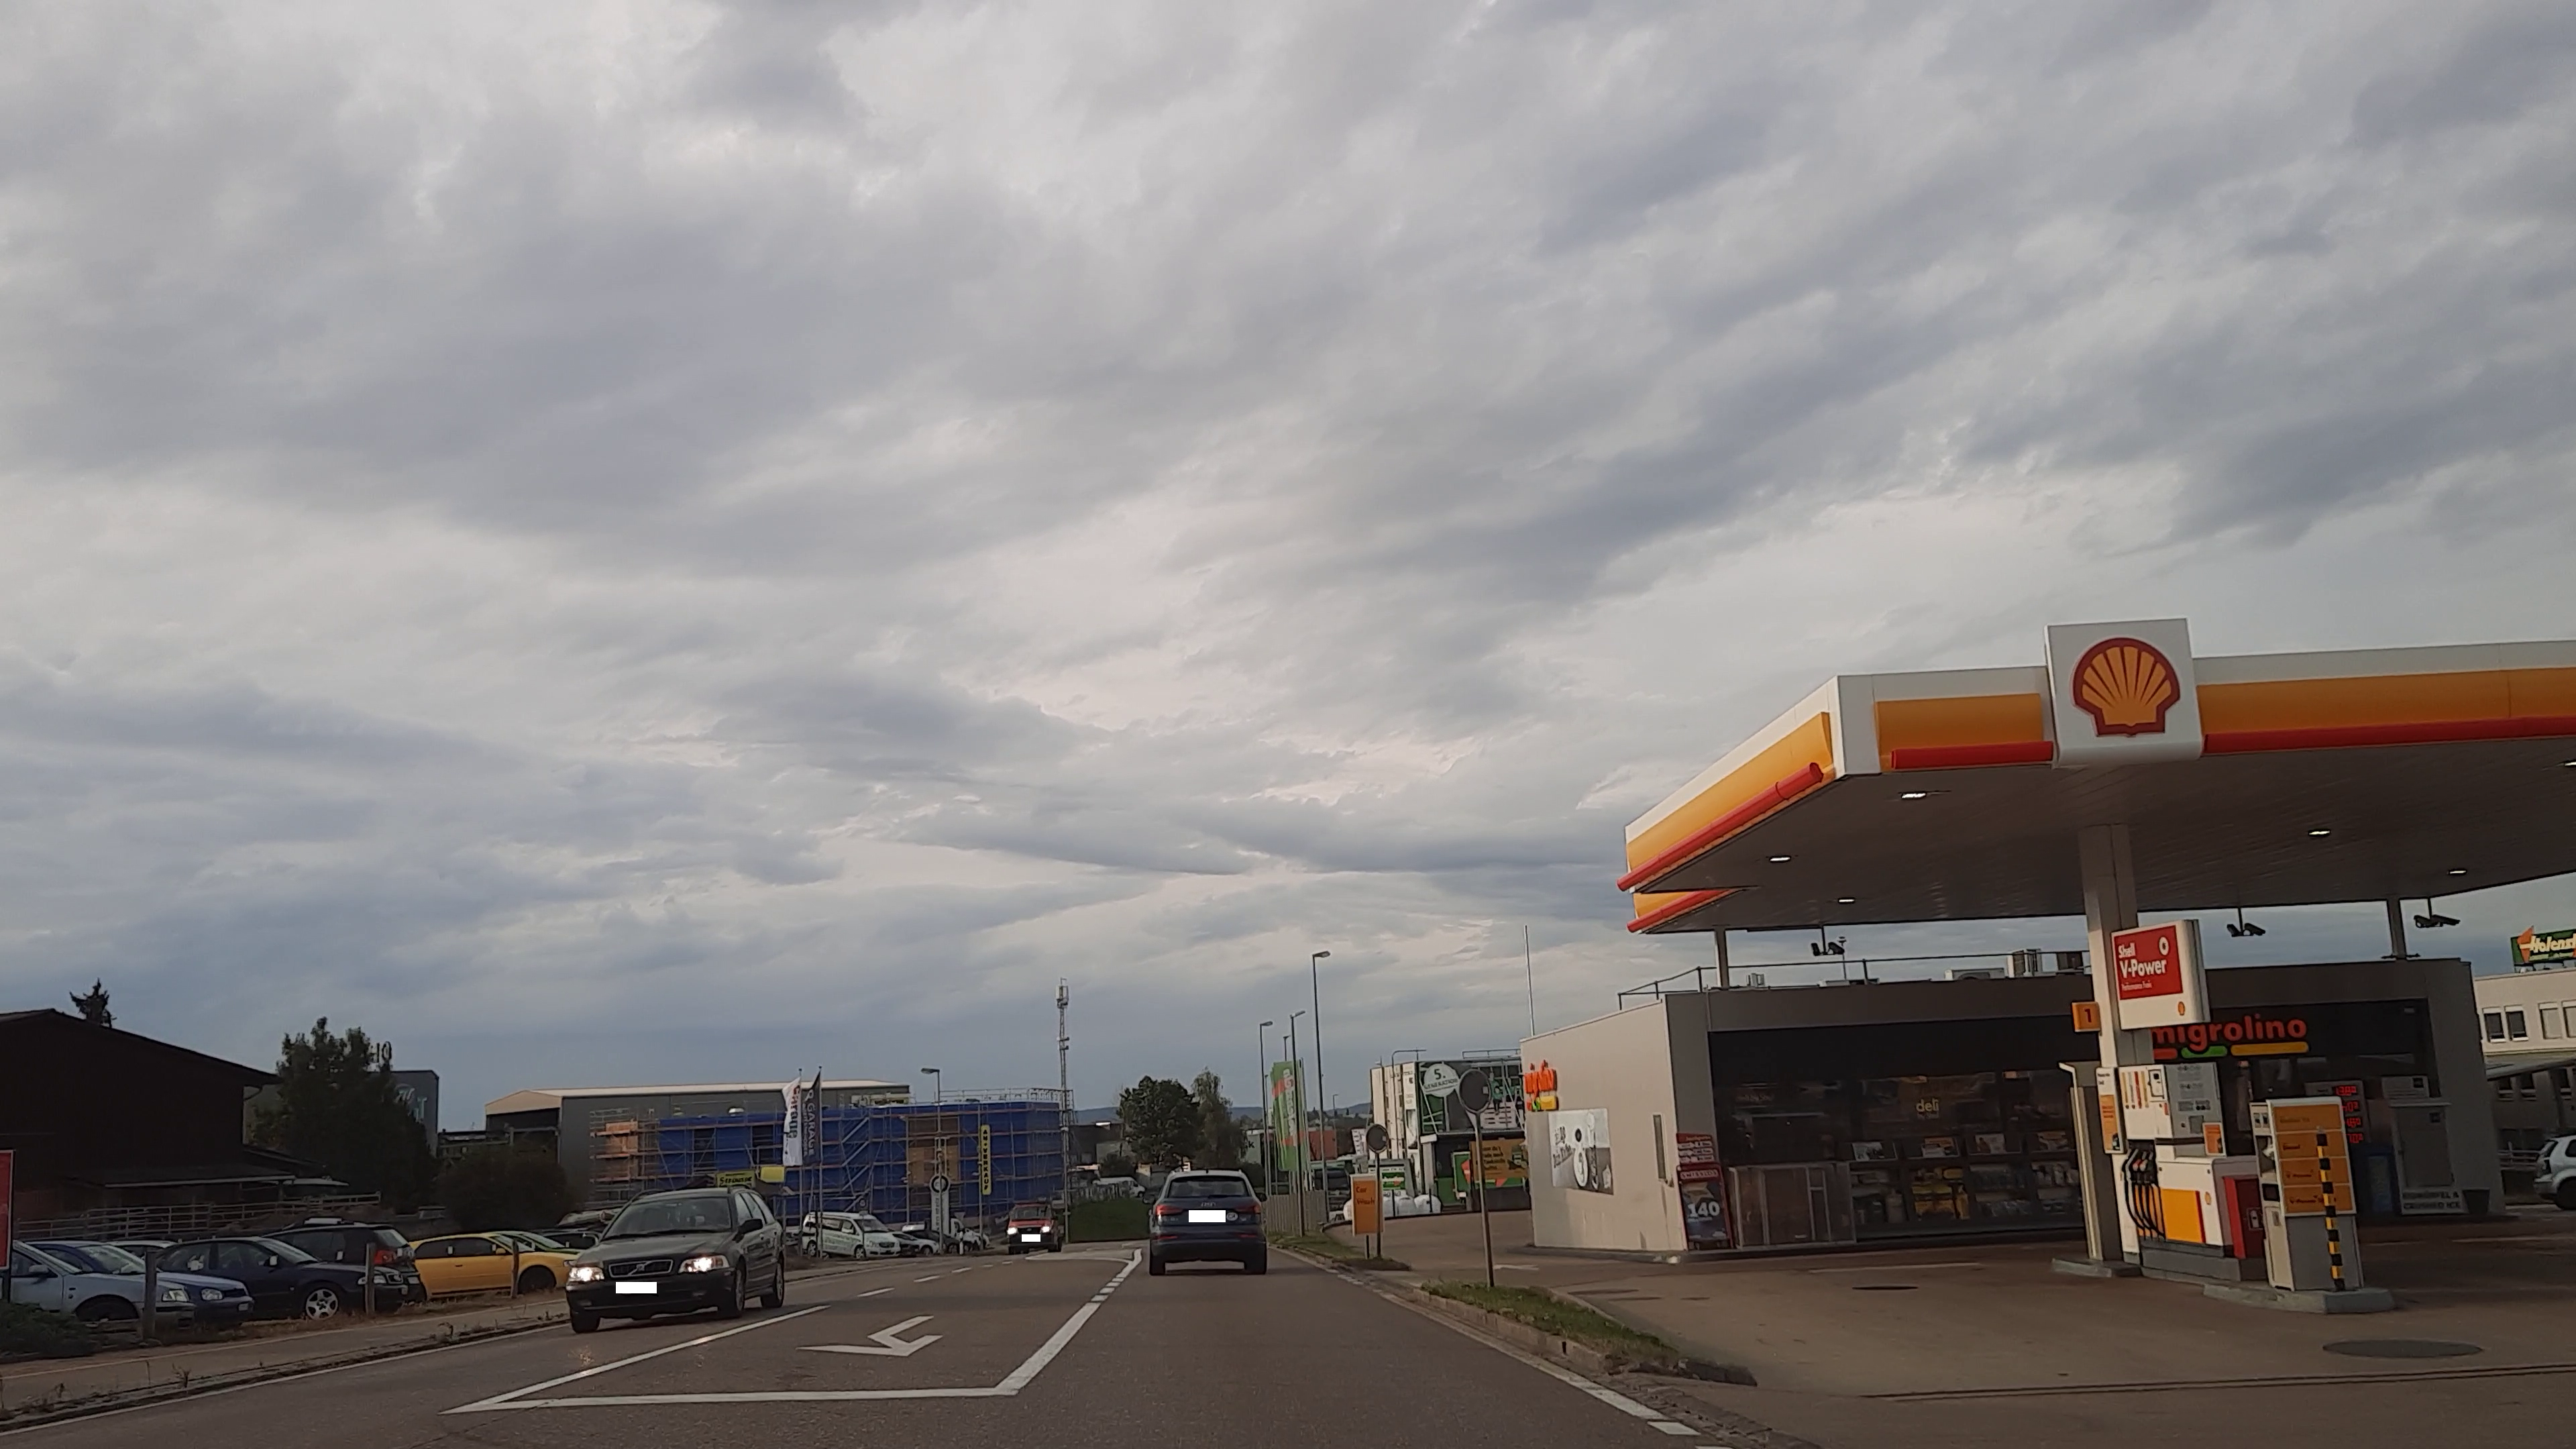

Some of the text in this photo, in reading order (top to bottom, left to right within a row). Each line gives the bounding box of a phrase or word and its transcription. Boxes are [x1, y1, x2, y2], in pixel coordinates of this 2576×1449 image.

[2118, 943, 2136, 959] Shell
[2119, 959, 2167, 979] V-Power
[2084, 1008, 2092, 1023] 1
[2151, 1013, 2308, 1051] migrolino
[1434, 1068, 1446, 1080] 5.
[1915, 1098, 1939, 1112] deli
[807, 1103, 816, 1157] GARAGE
[1687, 1201, 1720, 1218] 140
